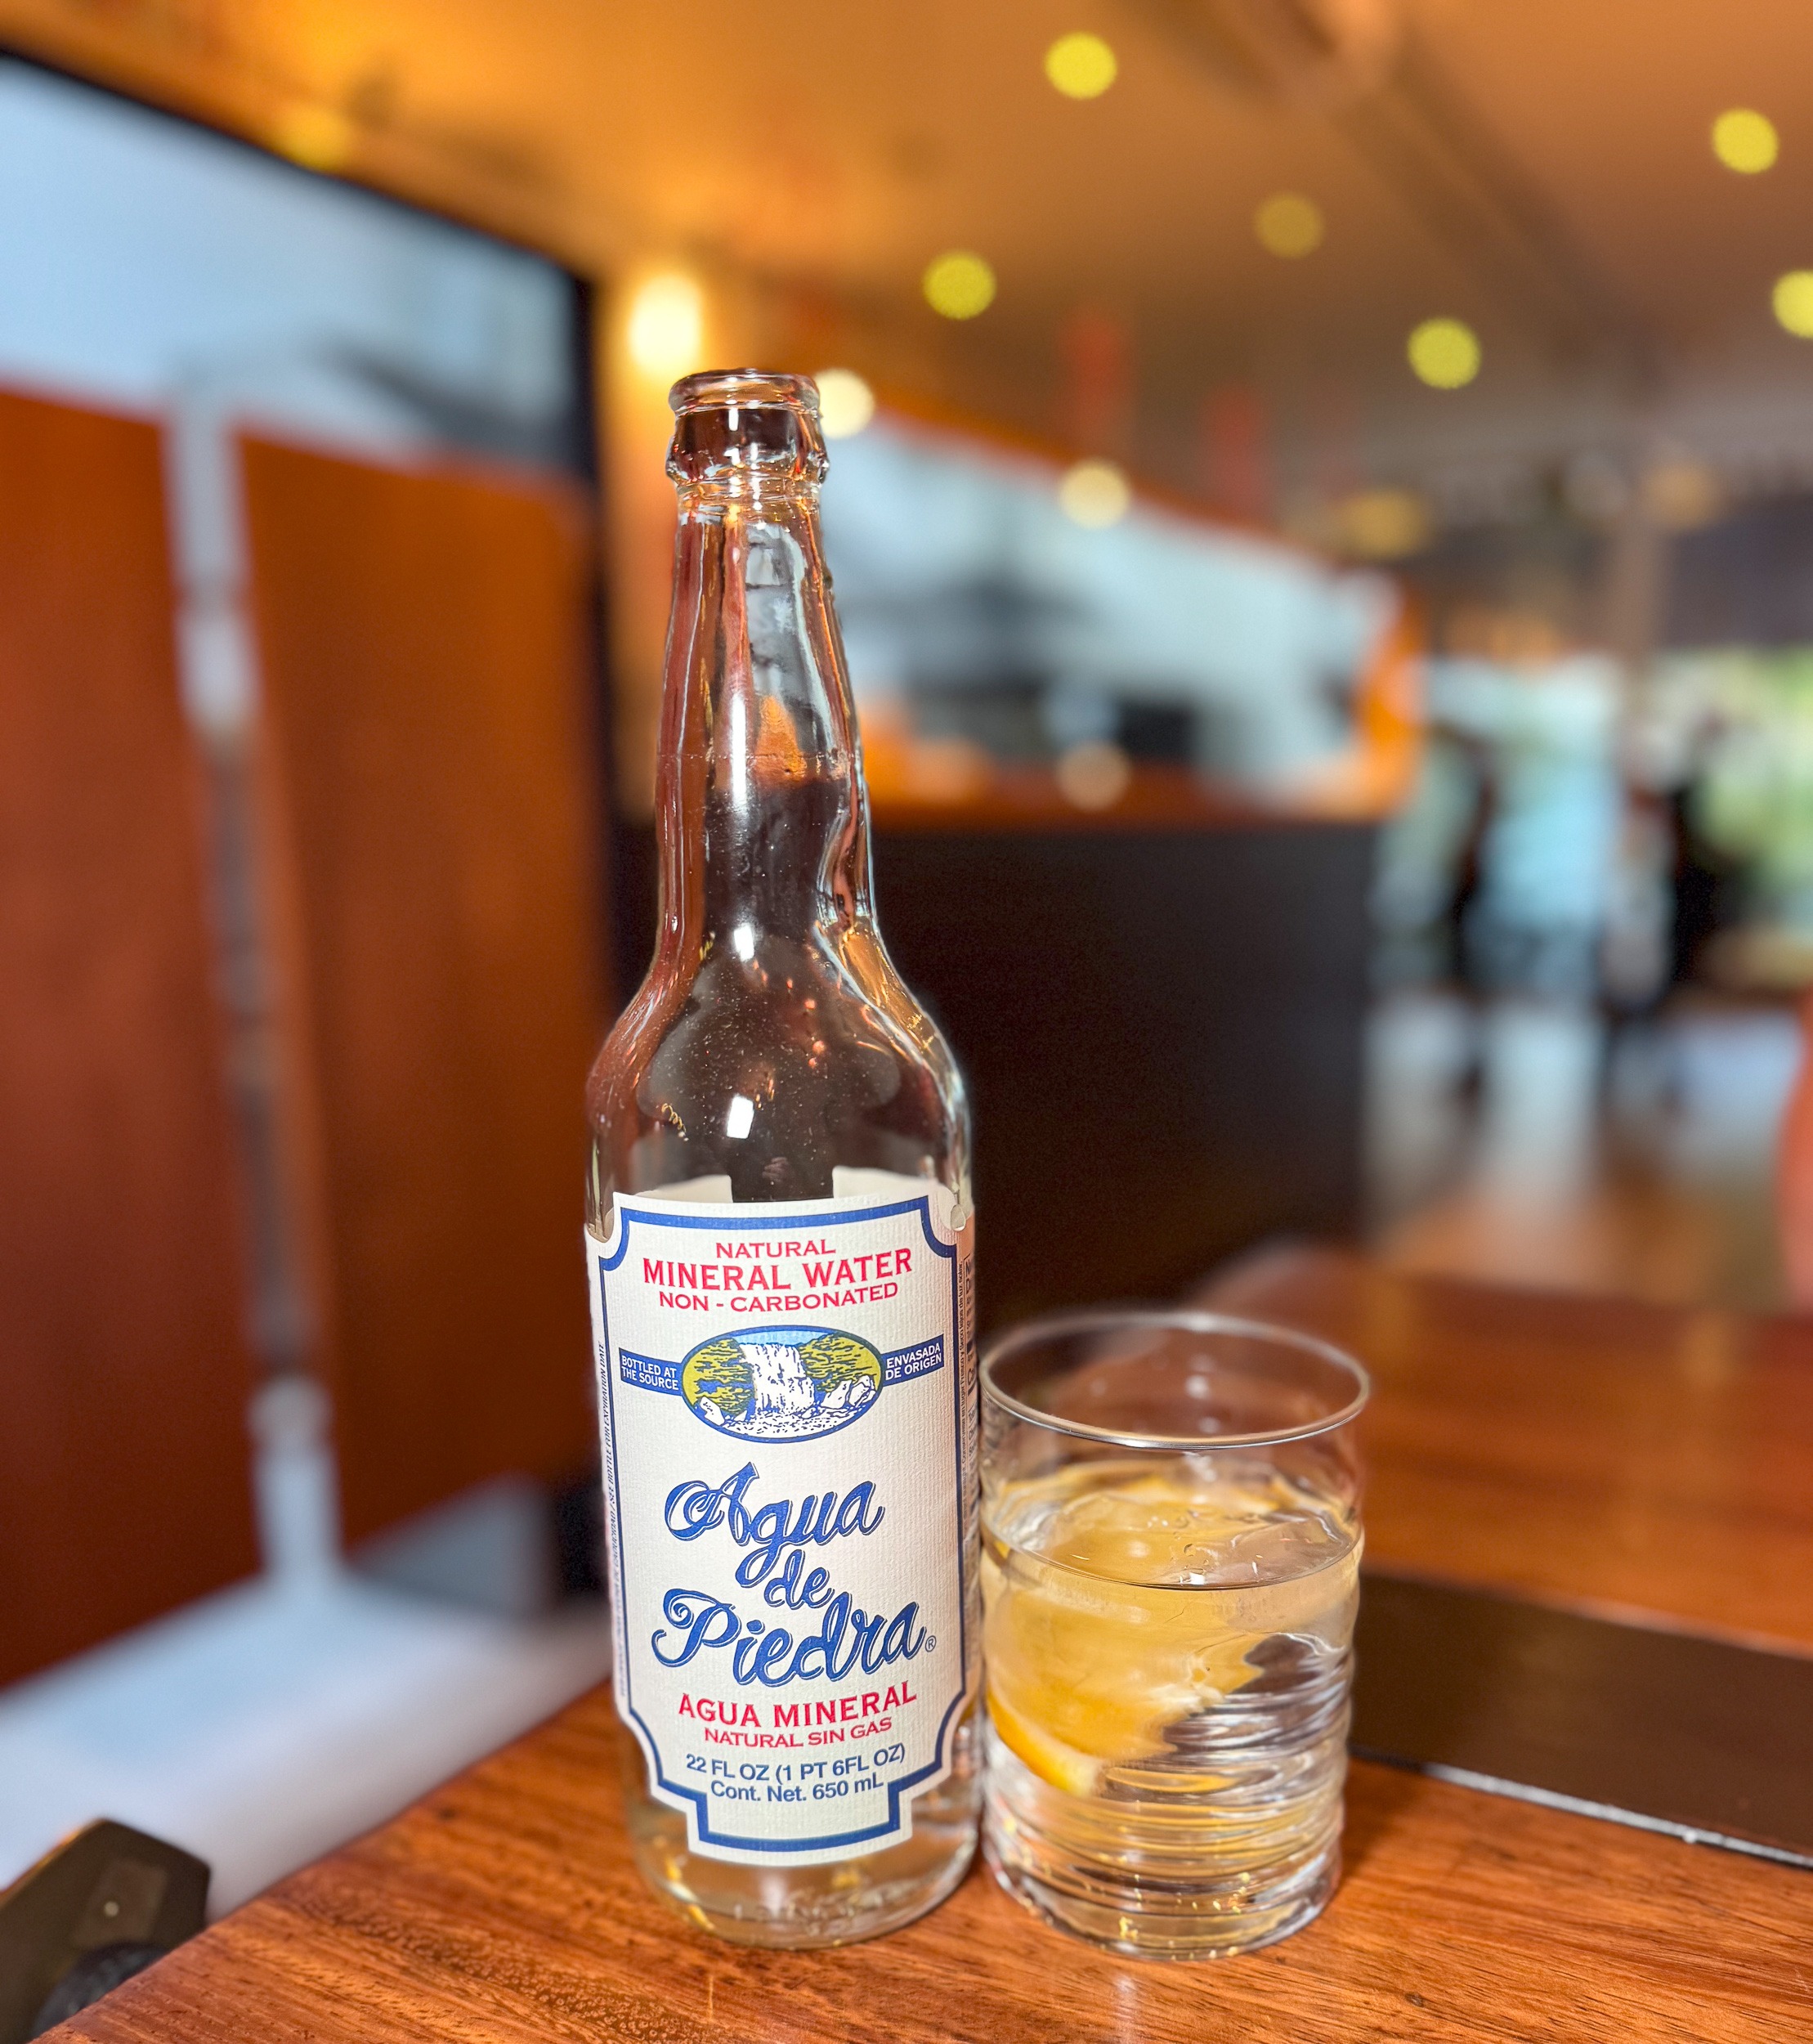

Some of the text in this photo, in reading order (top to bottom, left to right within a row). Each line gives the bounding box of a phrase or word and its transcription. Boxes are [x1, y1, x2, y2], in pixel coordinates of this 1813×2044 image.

[715, 1239, 836, 1259] NATURAL
[642, 1248, 912, 1291] MINERAL WATER
[659, 1291, 710, 1311] NON
[730, 1281, 898, 1313] CARBONATED
[621, 1355, 677, 1378] BOTTLED AT
[885, 1353, 942, 1380] DE ORIGEN
[886, 1342, 941, 1369] ENVASADA
[621, 1366, 679, 1391] THE SOURCE
[600, 1369, 610, 1426] EXPIRATION
[664, 1462, 885, 1589] Agua
[763, 1549, 835, 1611] de
[651, 1588, 927, 1688] Piedra
[678, 1680, 917, 1728] AGUA MINERAL
[704, 1717, 893, 1748] NATURAL SIN GAS
[686, 1753, 707, 1773] 22
[711, 1759, 736, 1778] FL
[739, 1763, 770, 1781] OZ
[775, 1764, 791, 1785] (1
[800, 1761, 828, 1780] PT
[873, 1742, 906, 1766] OZ)
[710, 1772, 884, 1802] Cont. Net. 650 mL
